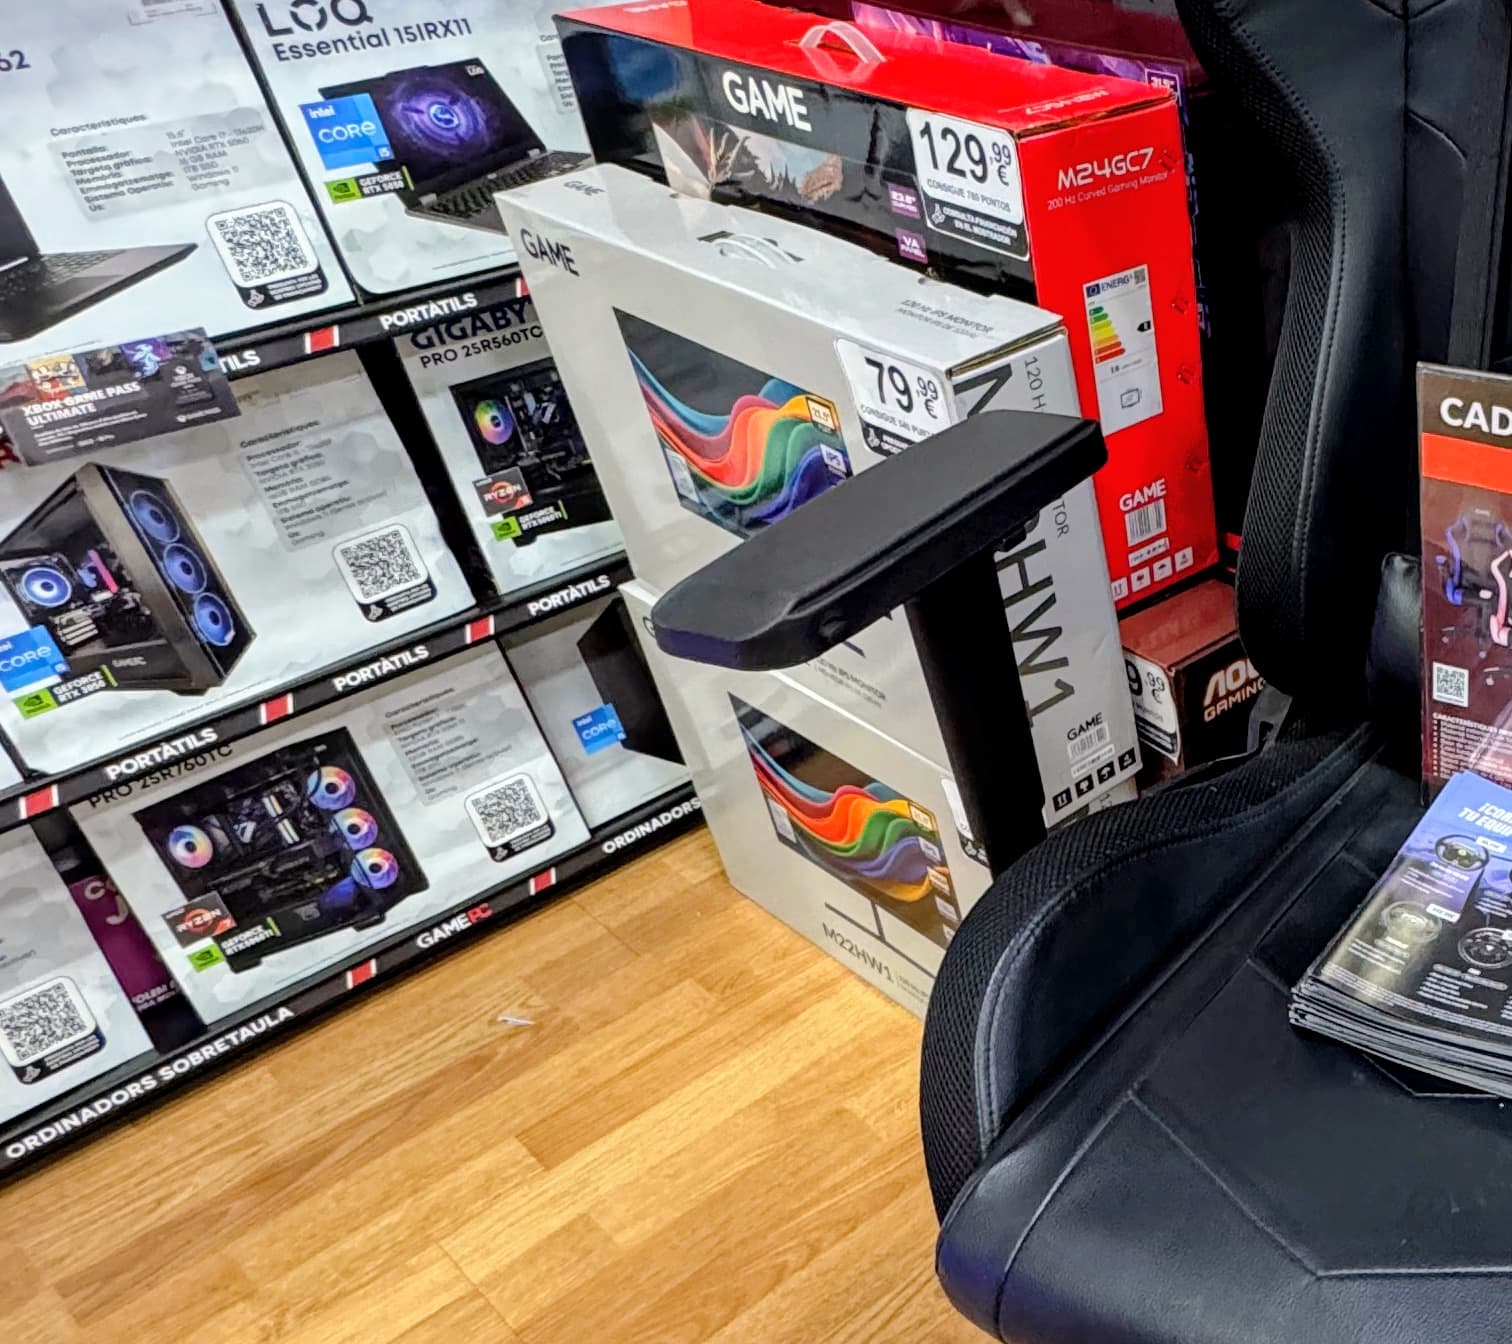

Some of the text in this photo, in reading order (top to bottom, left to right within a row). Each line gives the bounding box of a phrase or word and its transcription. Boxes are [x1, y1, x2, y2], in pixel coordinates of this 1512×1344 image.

[272, 17, 473, 63] Essential 15IRX11
[721, 70, 812, 133] GAME
[1057, 146, 1155, 192] M24GC7
[1077, 185, 1107, 204] Curved
[520, 227, 580, 278] GAME
[901, 233, 920, 249] VA
[379, 292, 478, 331] PORTÀTILS
[420, 348, 459, 370] PRO
[1024, 356, 1043, 392] 120
[108, 381, 142, 398] PASS
[26, 402, 97, 428] ULTIMATE
[1119, 478, 1168, 513] GAME
[527, 574, 612, 617] PORTÀTILS
[331, 645, 431, 693] PORTÀTILS
[1066, 711, 1104, 742] GAME
[105, 727, 219, 781] PORTÀTILS
[87, 779, 134, 810] PRO
[600, 795, 701, 856] ORDINADORS
[1457, 806, 1476, 823] TU
[821, 921, 895, 984] M22HW1
[4, 1005, 296, 1161] ORDINADORS SOBRETAULA
